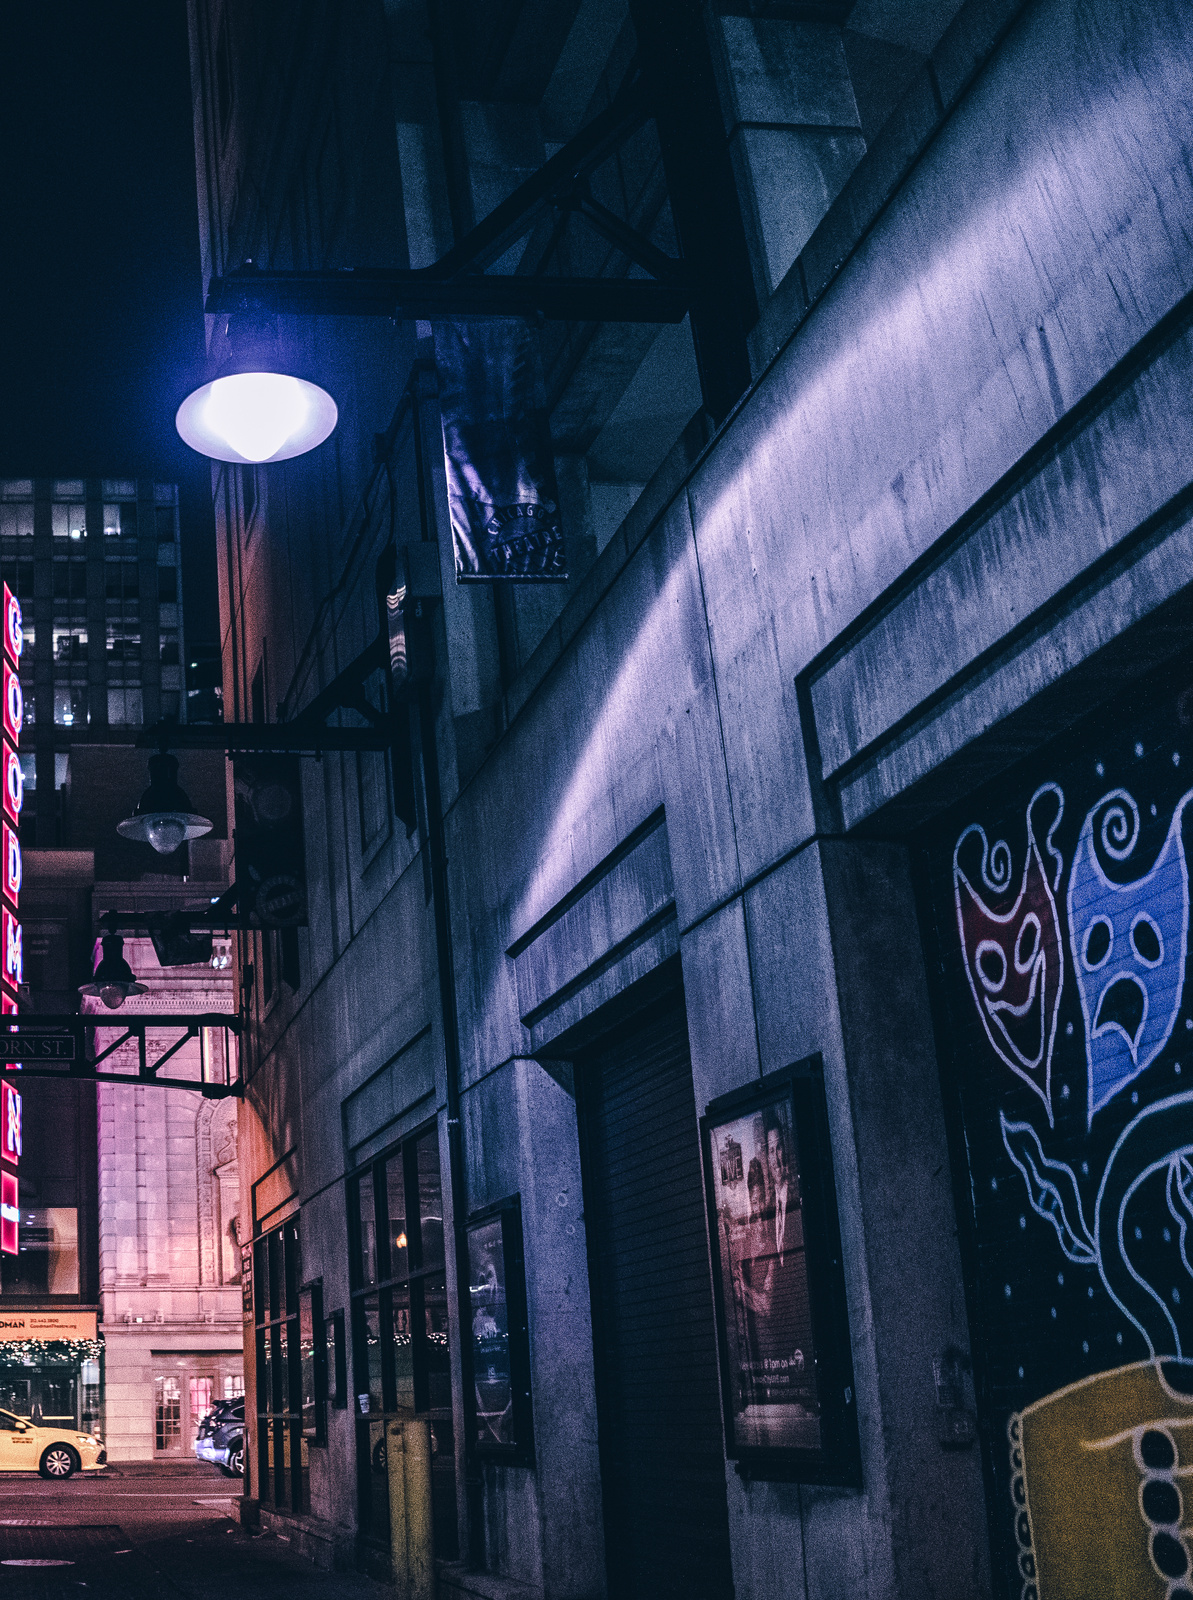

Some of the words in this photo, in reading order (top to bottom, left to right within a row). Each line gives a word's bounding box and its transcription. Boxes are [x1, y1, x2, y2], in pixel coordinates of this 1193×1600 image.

[487, 504, 546, 535] CHICAGO
[490, 525, 562, 562] THEATRE
[41, 1040, 67, 1055] ST.
